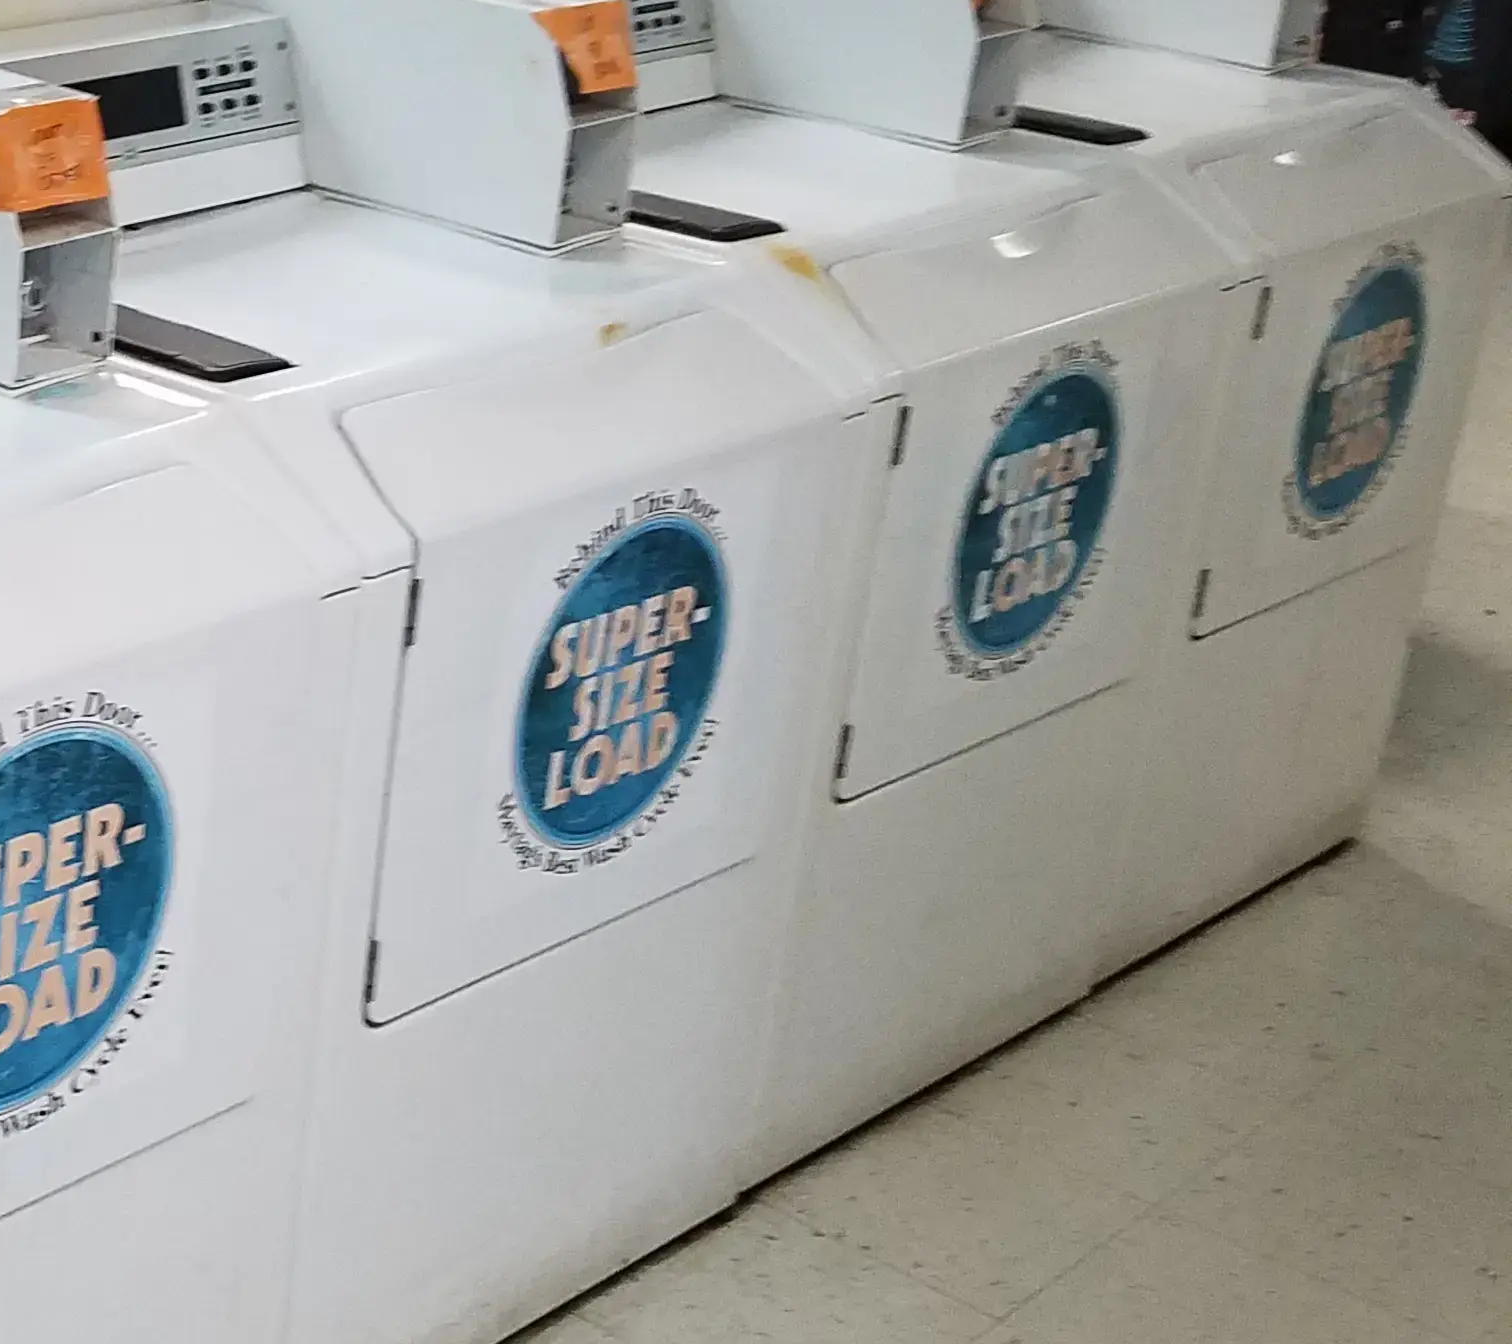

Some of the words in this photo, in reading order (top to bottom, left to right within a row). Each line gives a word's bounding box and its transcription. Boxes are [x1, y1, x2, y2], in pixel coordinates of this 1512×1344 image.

[545, 586, 712, 690] SUPER-
[568, 650, 675, 742] SIZE
[542, 711, 679, 811] LOAD
